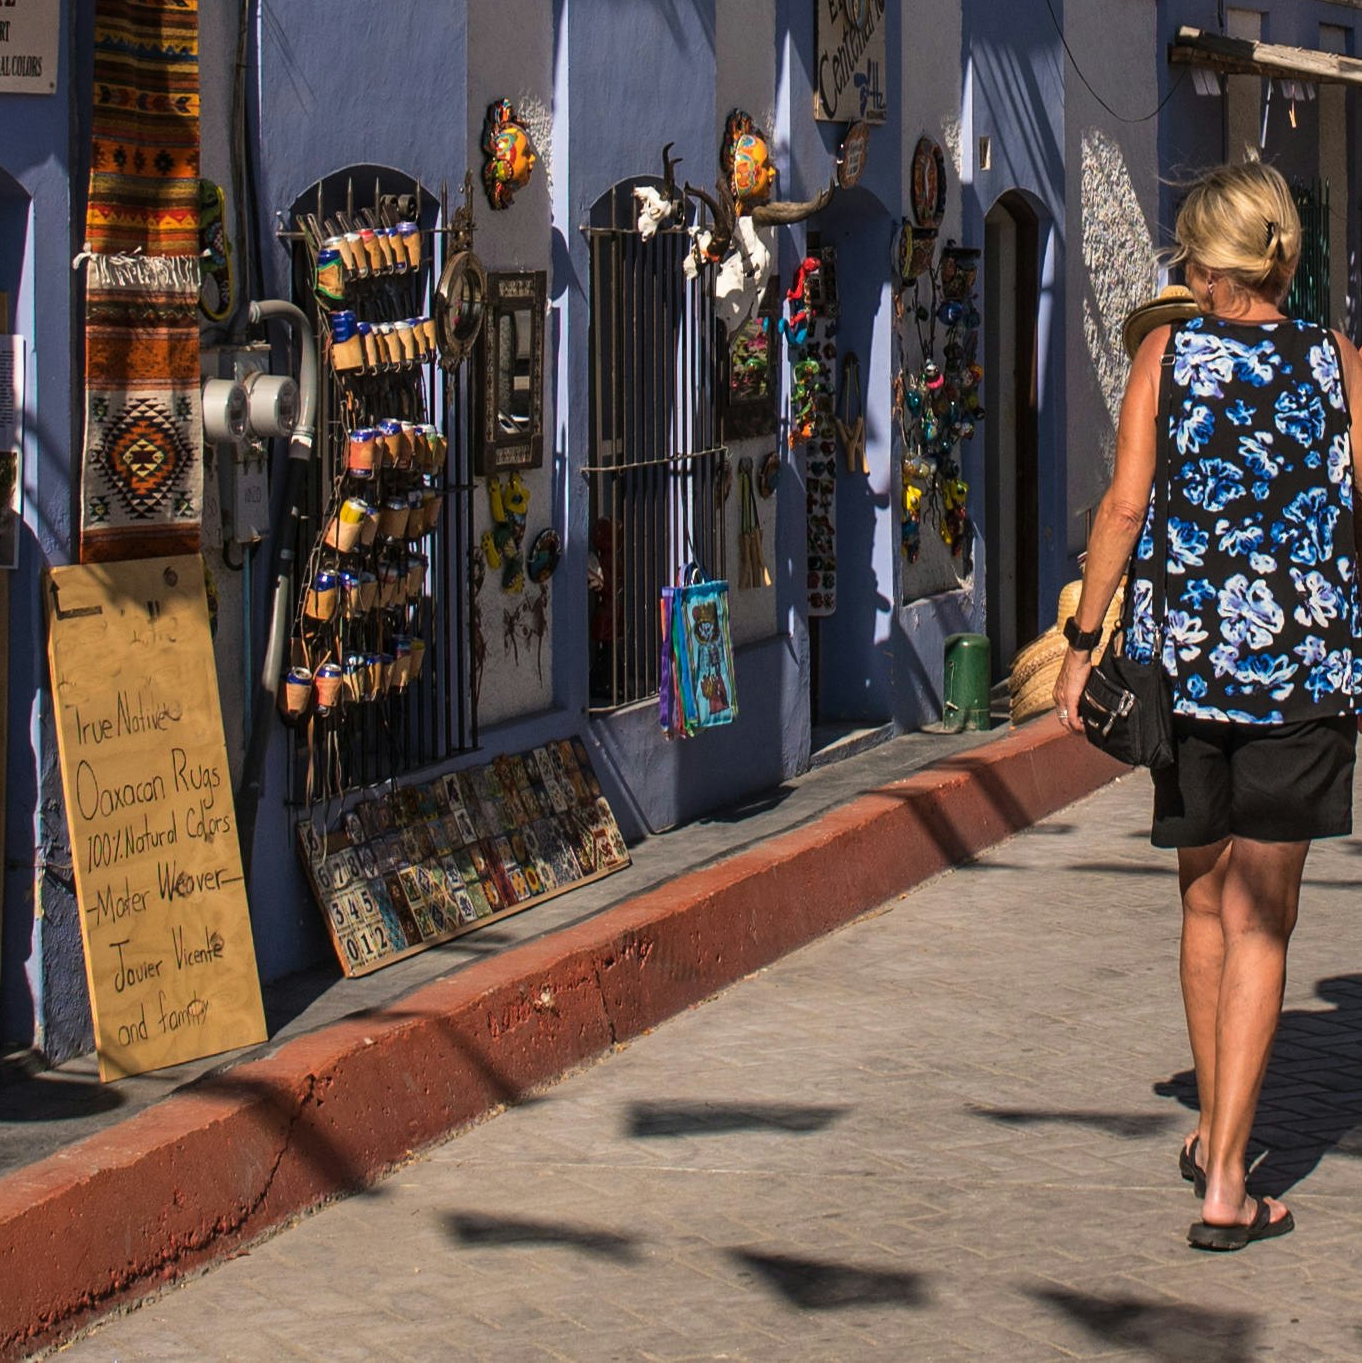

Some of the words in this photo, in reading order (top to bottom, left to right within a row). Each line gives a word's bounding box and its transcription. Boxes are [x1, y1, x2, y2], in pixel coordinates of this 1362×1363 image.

[12, 55, 43, 77] COLORS
[65, 704, 114, 745] True
[76, 759, 166, 821] Oaxacan
[172, 747, 221, 810] Rugs
[87, 829, 124, 875] 100%
[124, 810, 178, 860] Natural
[187, 798, 231, 844] Colors
[317, 867, 330, 889] 6
[333, 862, 345, 884] 7
[347, 854, 360, 878] 8
[331, 901, 345, 926] 3
[347, 896, 360, 920] 4
[361, 890, 374, 914] 5
[109, 939, 163, 993] Javier
[172, 925, 225, 970] Vicente
[346, 938, 359, 962] 0
[361, 933, 374, 956] 1
[374, 926, 387, 950] 2
[118, 1002, 148, 1047] and
